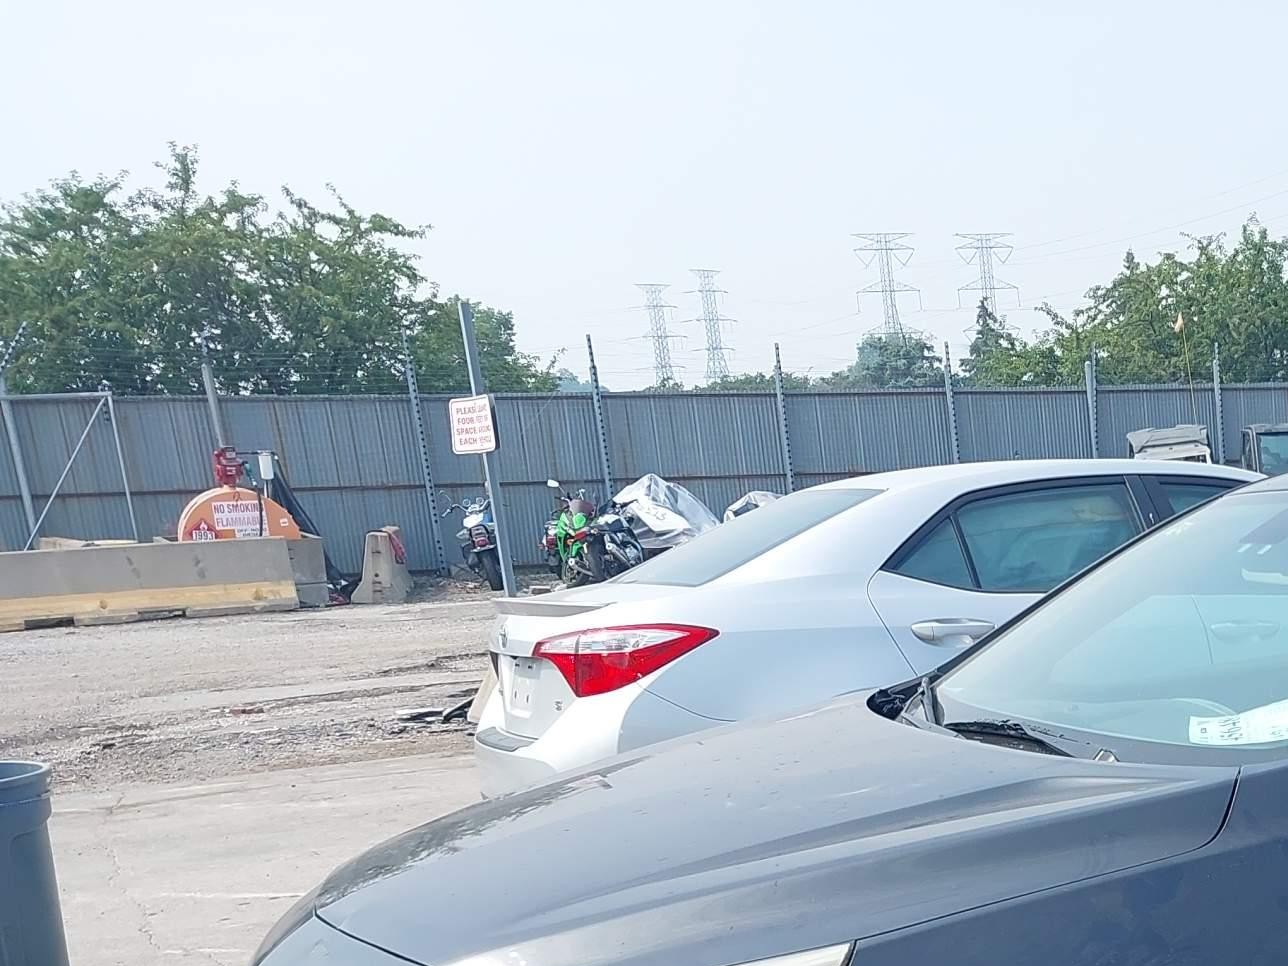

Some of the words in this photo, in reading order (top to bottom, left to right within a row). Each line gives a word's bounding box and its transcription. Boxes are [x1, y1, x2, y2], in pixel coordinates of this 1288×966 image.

[456, 428, 478, 436] SPACE
[459, 438, 477, 446] EACH
[213, 503, 225, 514] NO
[226, 502, 264, 514] SMOKIN
[194, 530, 214, 540] 1993
